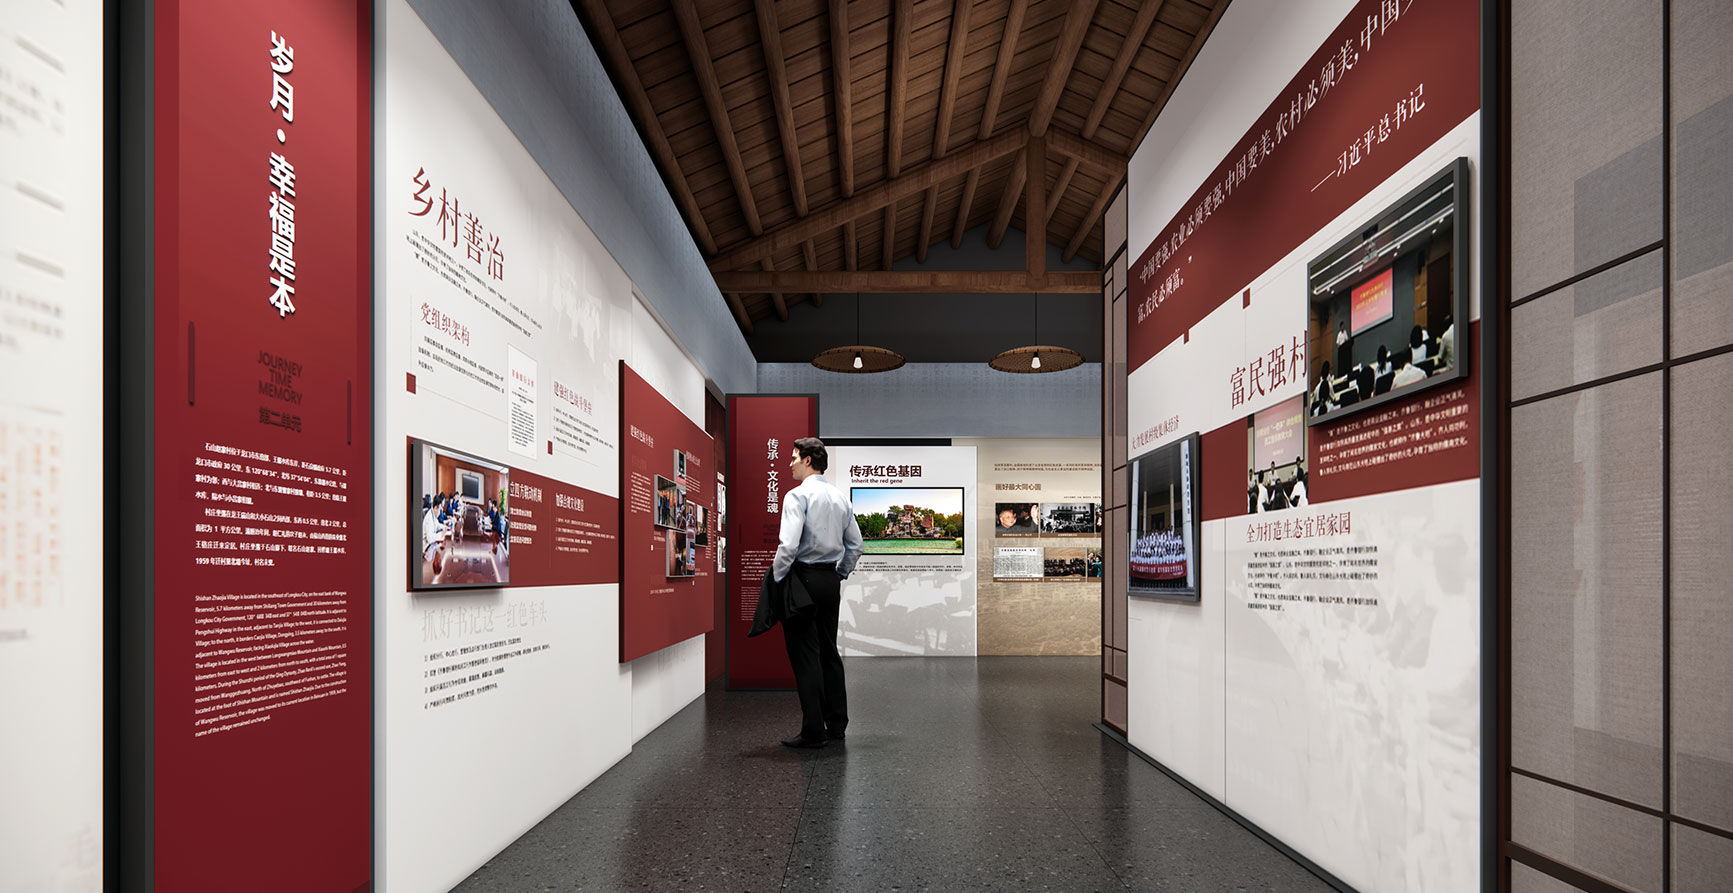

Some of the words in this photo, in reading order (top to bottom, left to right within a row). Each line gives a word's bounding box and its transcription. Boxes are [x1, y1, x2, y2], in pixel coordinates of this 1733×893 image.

[408, 166, 504, 281] 乡村善治
[421, 302, 470, 347] 党组织架构
[258, 350, 302, 376] JOURNEY
[1230, 330, 1307, 410] 富民强村
[258, 380, 302, 405] MEMORY
[269, 368, 292, 388] TIME
[259, 406, 302, 432] 第二单元
[767, 438, 779, 514] 传承·文化是魂
[849, 465, 922, 477] 传承红色基因
[1246, 511, 1351, 543] 全力打造生态宜居家园
